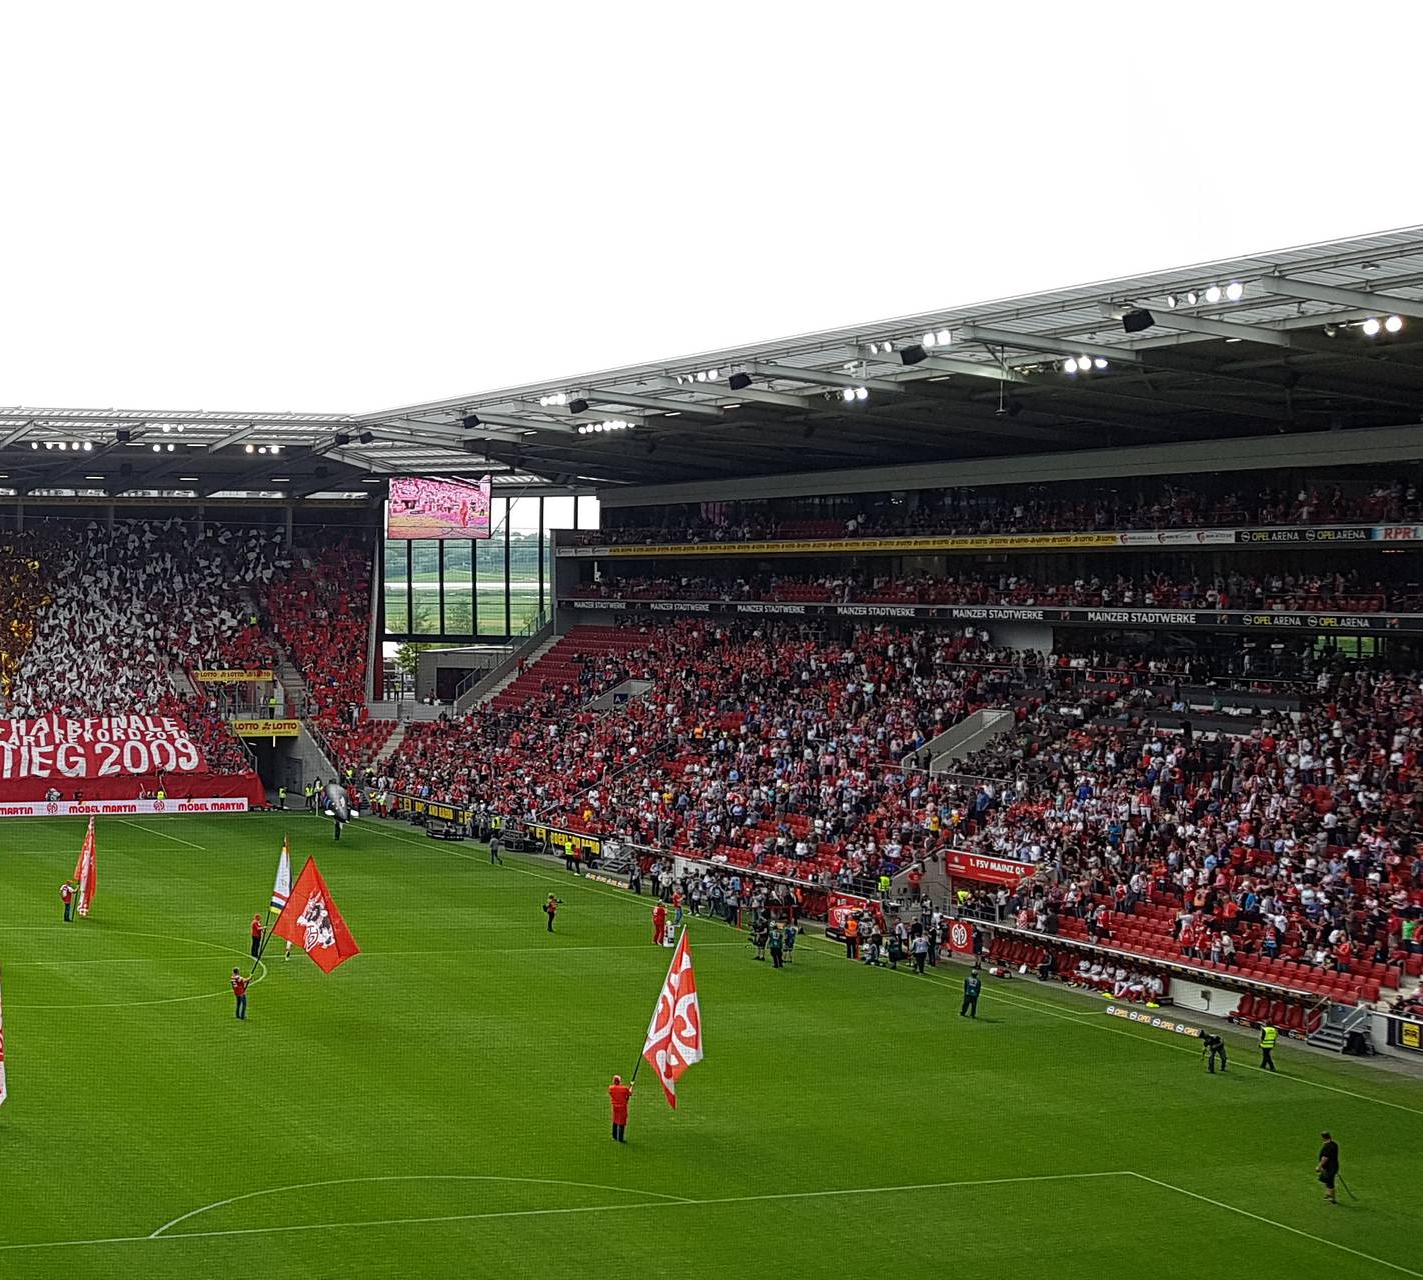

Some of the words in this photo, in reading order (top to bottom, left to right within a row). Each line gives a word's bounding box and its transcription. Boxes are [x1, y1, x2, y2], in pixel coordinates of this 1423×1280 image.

[1252, 532, 1271, 542] OPEL
[1271, 531, 1300, 541] ARENA
[1317, 530, 1336, 541] OPEL
[1336, 530, 1366, 540] ARENA
[837, 606, 867, 616] MAINZER
[868, 607, 916, 617] STADTWERKE
[952, 609, 987, 619] MAINZER
[988, 610, 1044, 620] STADTWERKE
[1088, 611, 1129, 622] MAINZER
[1131, 612, 1197, 624] STADTWERKE
[1253, 615, 1272, 625] OPEL
[1273, 615, 1301, 627] ARENA
[1319, 617, 1338, 627] OPEL
[1340, 618, 1369, 628] ARENA
[234, 722, 259, 730] LOTTO
[272, 721, 297, 730] LOTTO
[93, 736, 201, 778] 2009
[102, 804, 137, 813] MARTIN
[211, 802, 245, 811] MARTIN
[976, 859, 990, 870] FSV
[989, 862, 1015, 874] MAINZ
